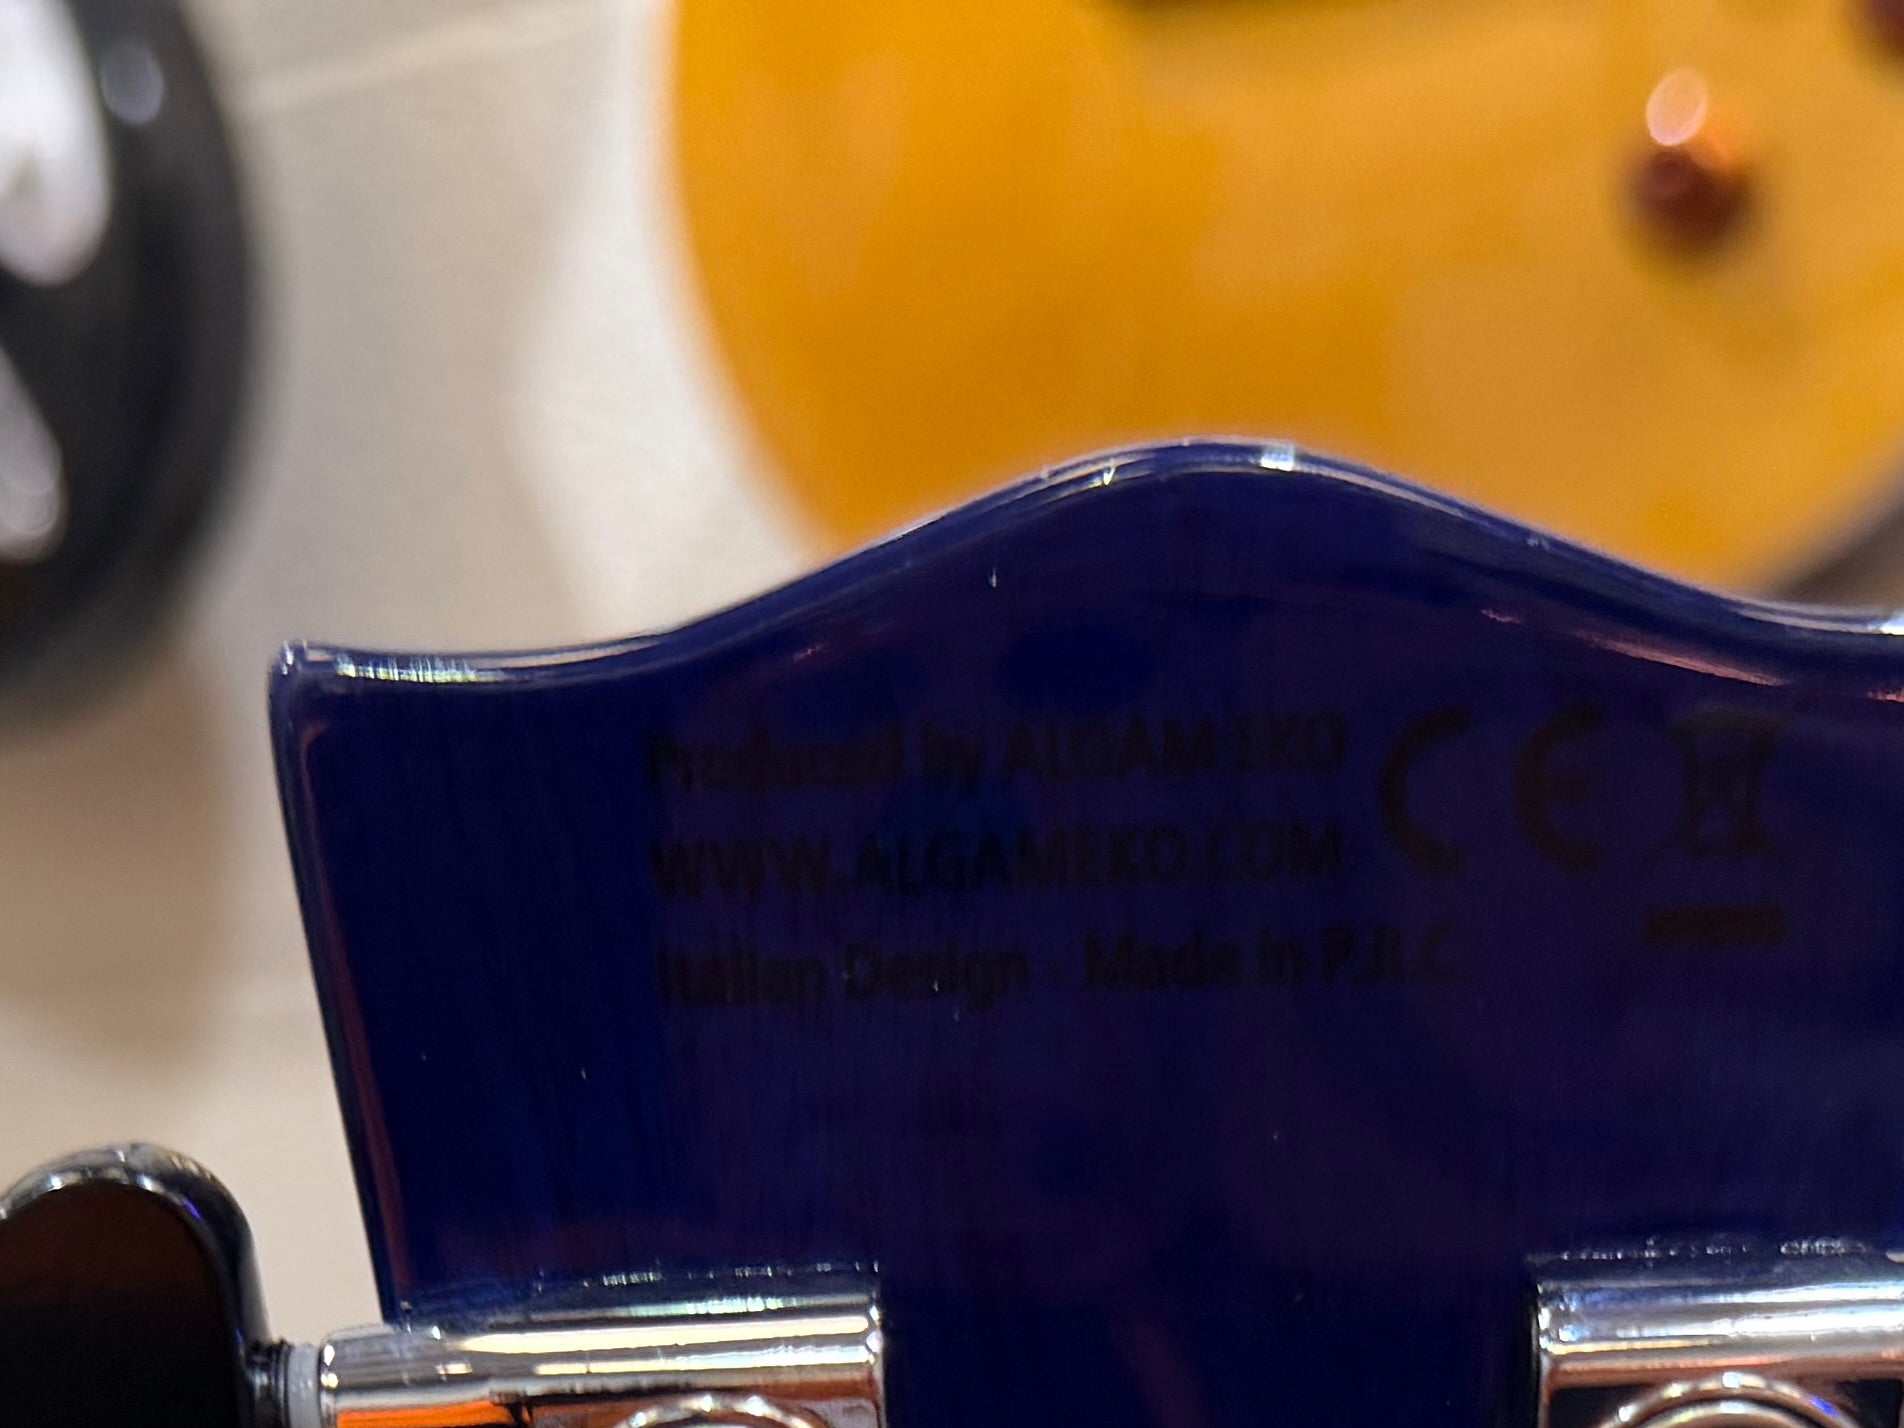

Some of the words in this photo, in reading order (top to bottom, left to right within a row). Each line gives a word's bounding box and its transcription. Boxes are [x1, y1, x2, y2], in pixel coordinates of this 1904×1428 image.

[646, 703, 902, 795] Produced
[921, 703, 984, 799] by
[1004, 708, 1216, 778] ALGAM
[1236, 706, 1346, 773] EKO
[648, 820, 1343, 898] WWW.ALGAMEKO.COM
[654, 933, 829, 1007] Italian
[846, 935, 1030, 1010] Design
[1083, 923, 1239, 990] Made
[1256, 927, 1306, 987] in
